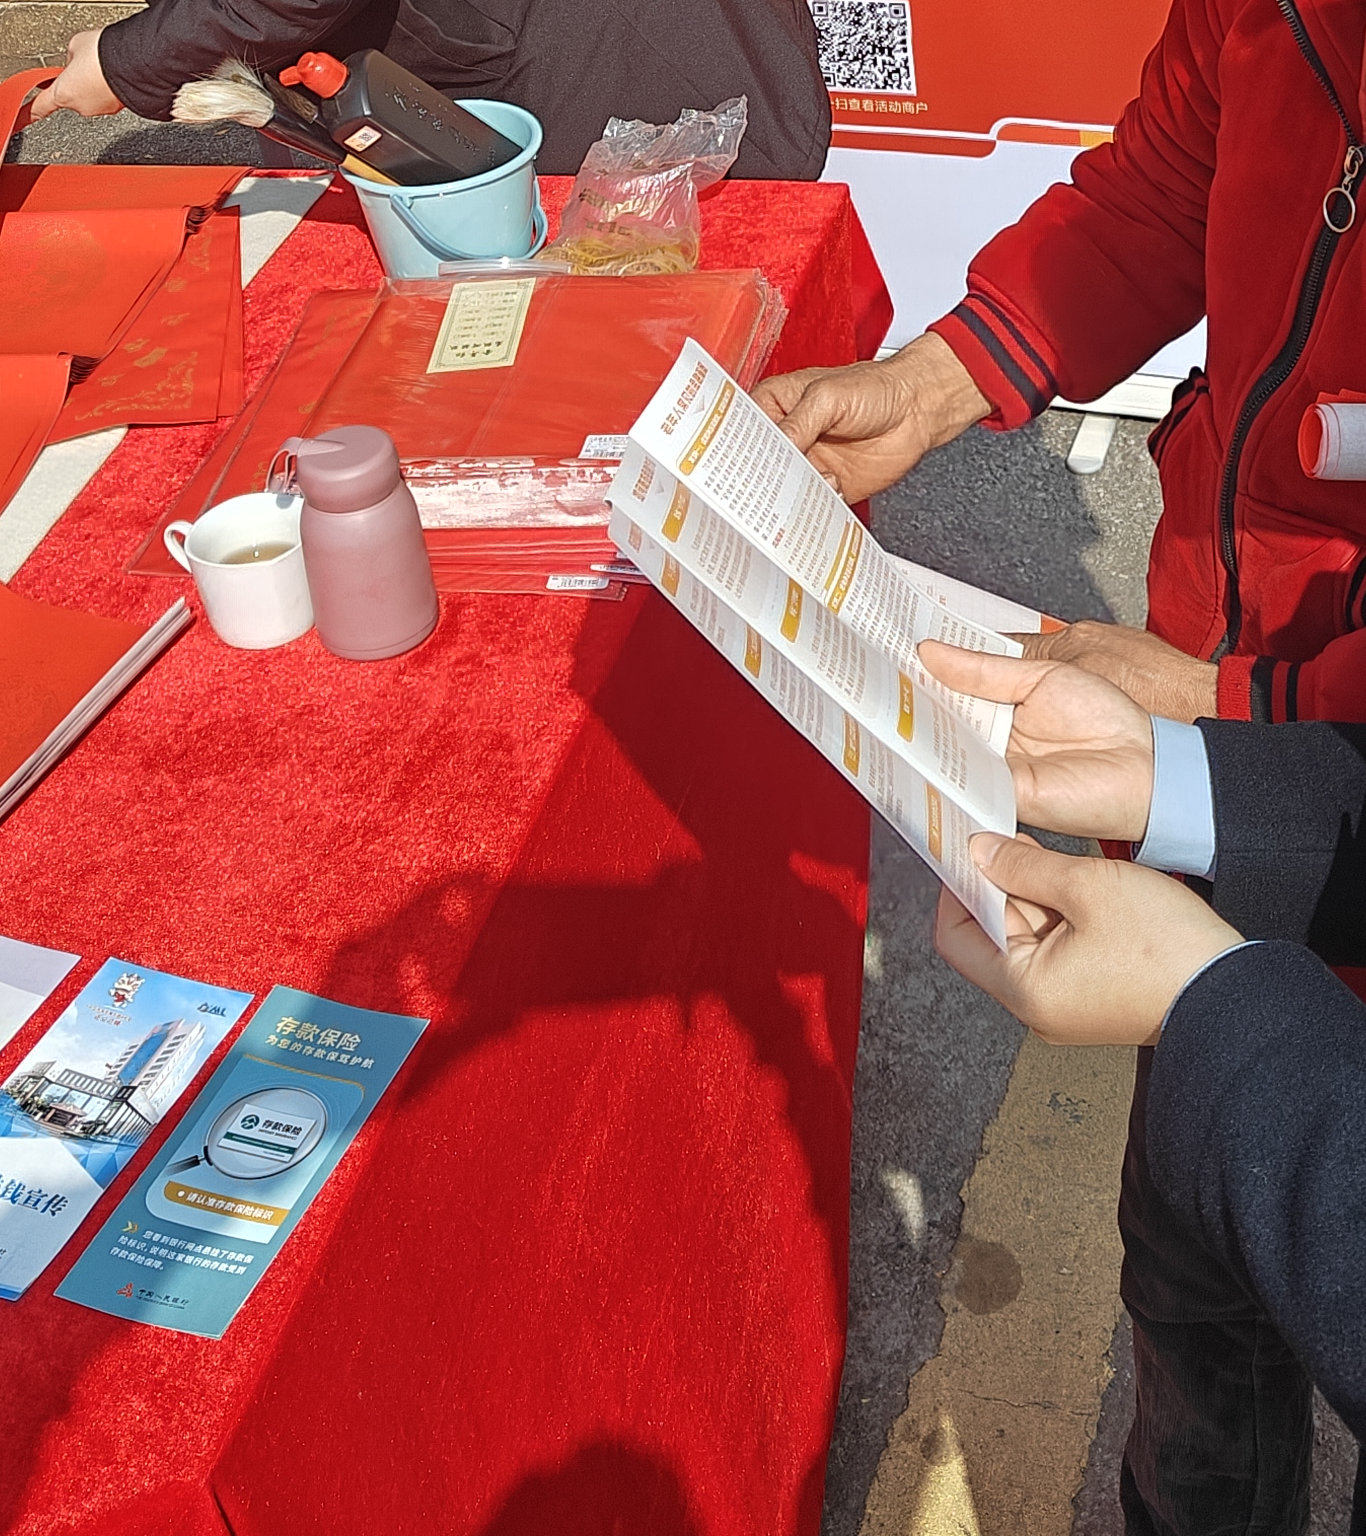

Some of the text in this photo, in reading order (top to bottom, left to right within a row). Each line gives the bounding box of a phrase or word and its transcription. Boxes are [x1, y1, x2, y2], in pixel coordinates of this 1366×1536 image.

[275, 1014, 362, 1049] 存款保险
[265, 1035, 375, 1071] 为您的存款保驾护航
[262, 1119, 303, 1137] 存款保险
[186, 1191, 274, 1221] 请认准存款保险标识
